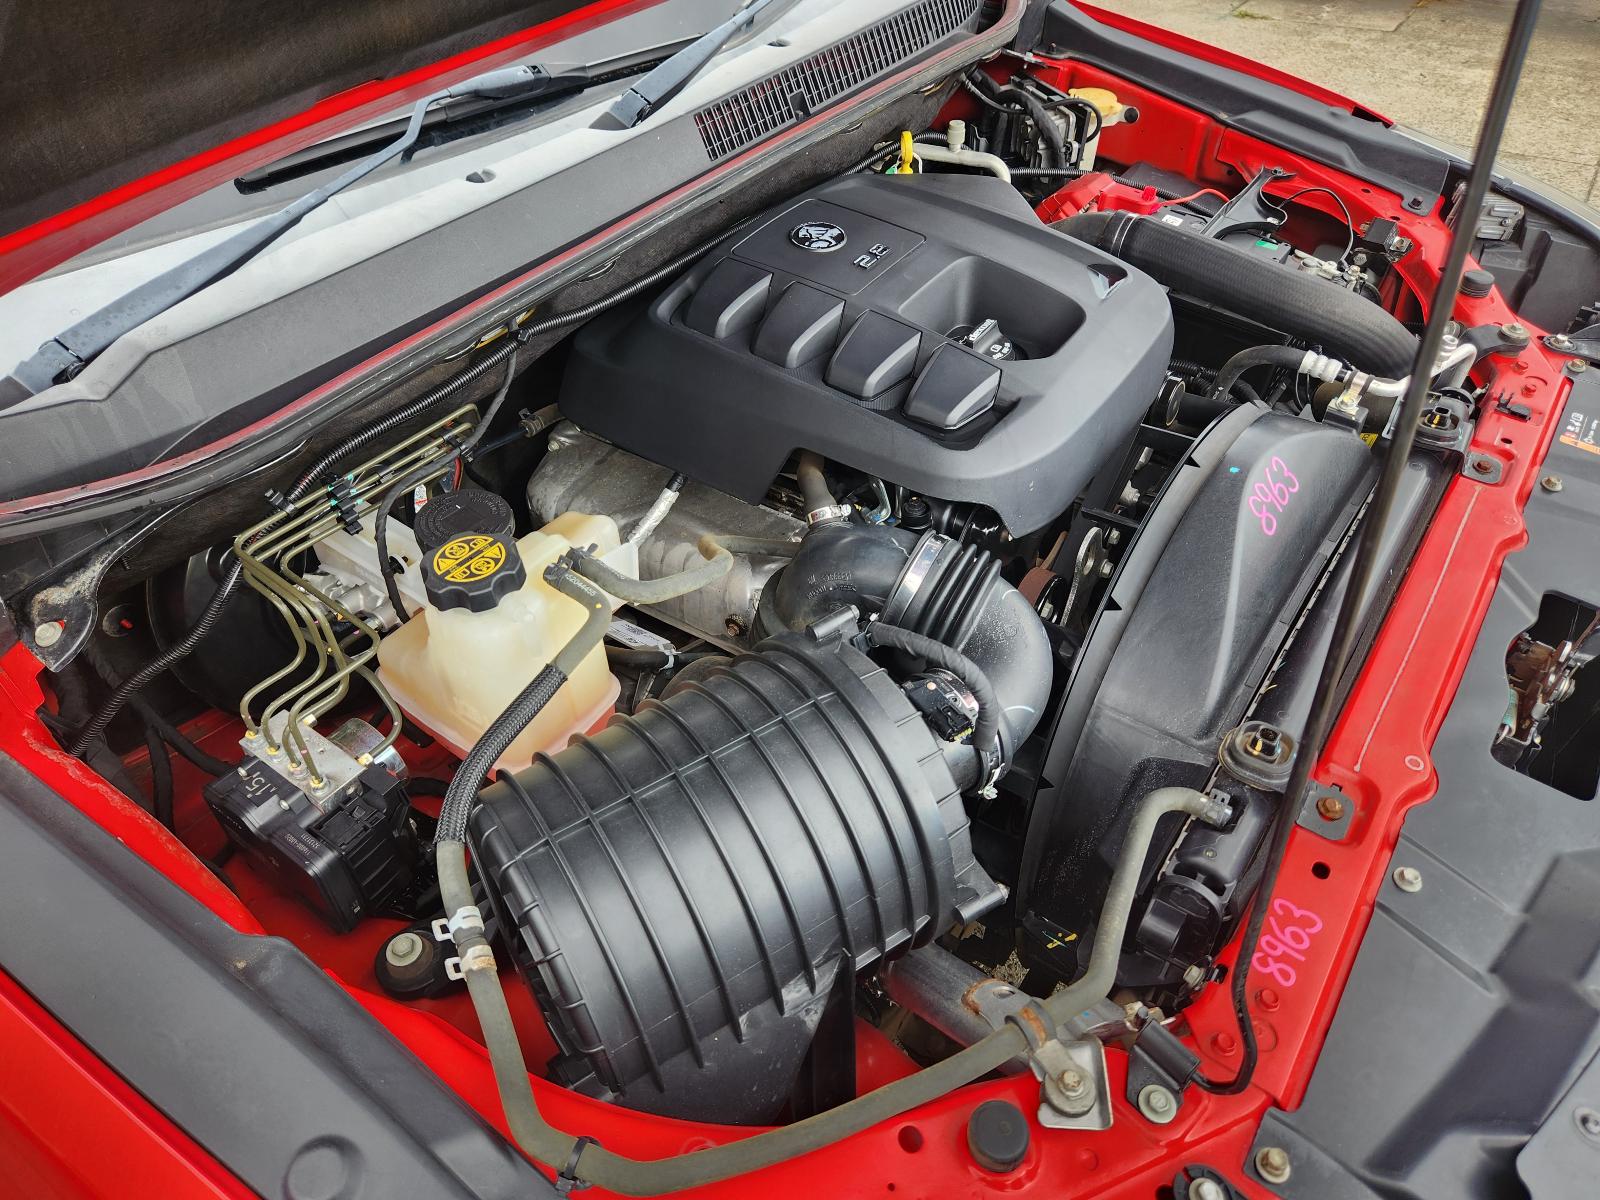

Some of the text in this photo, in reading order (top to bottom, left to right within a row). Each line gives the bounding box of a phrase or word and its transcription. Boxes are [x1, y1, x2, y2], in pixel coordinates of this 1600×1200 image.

[853, 243, 890, 269] 2.8
[1248, 456, 1299, 536] 8963
[1251, 898, 1323, 988] 8963
